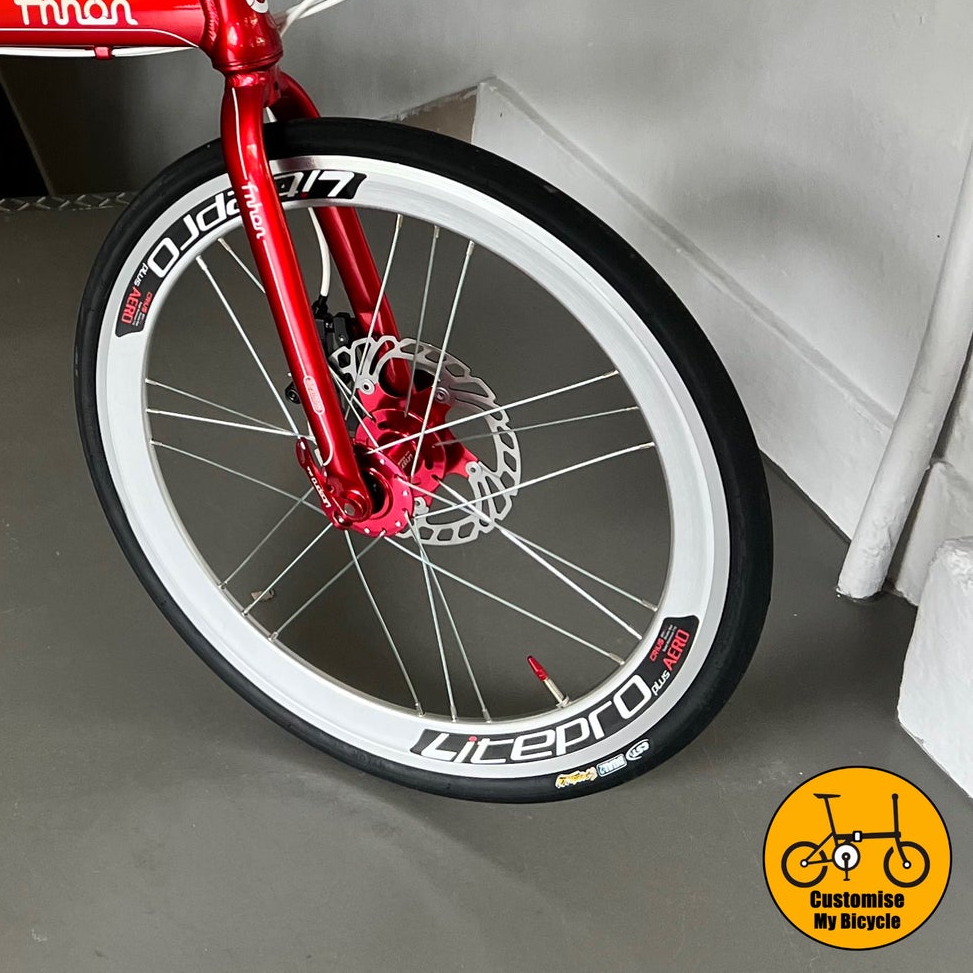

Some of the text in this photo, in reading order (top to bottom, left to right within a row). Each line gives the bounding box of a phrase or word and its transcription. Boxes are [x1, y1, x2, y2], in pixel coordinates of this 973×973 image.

[121, 286, 142, 324] AERO
[421, 674, 653, 764] Litepro
[651, 669, 671, 696] plus
[663, 628, 690, 671] AERO
